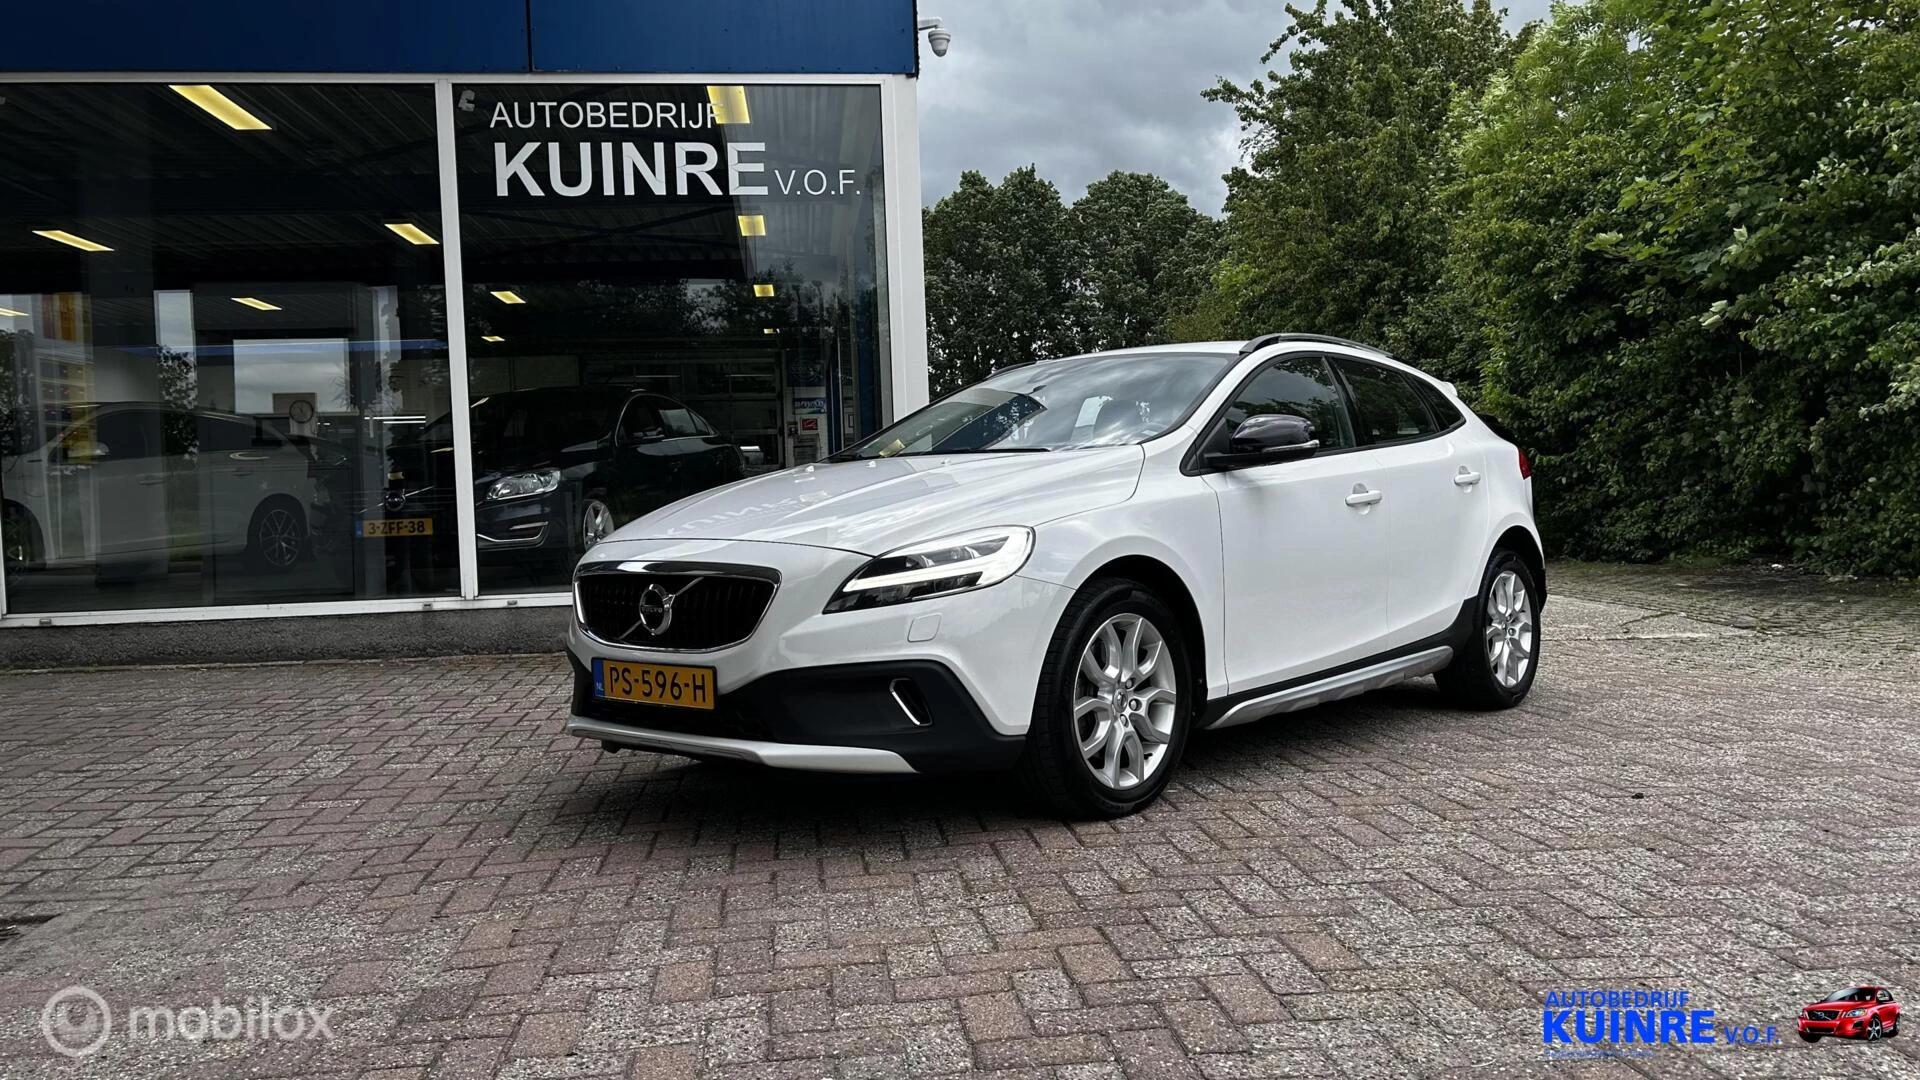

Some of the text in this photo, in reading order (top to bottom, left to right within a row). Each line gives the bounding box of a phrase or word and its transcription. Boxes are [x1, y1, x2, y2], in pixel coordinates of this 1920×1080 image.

[494, 141, 861, 197] KUINRE V.O.F.
[368, 520, 425, 535] 3-ZFF-38
[609, 665, 706, 703] PS-596-H
